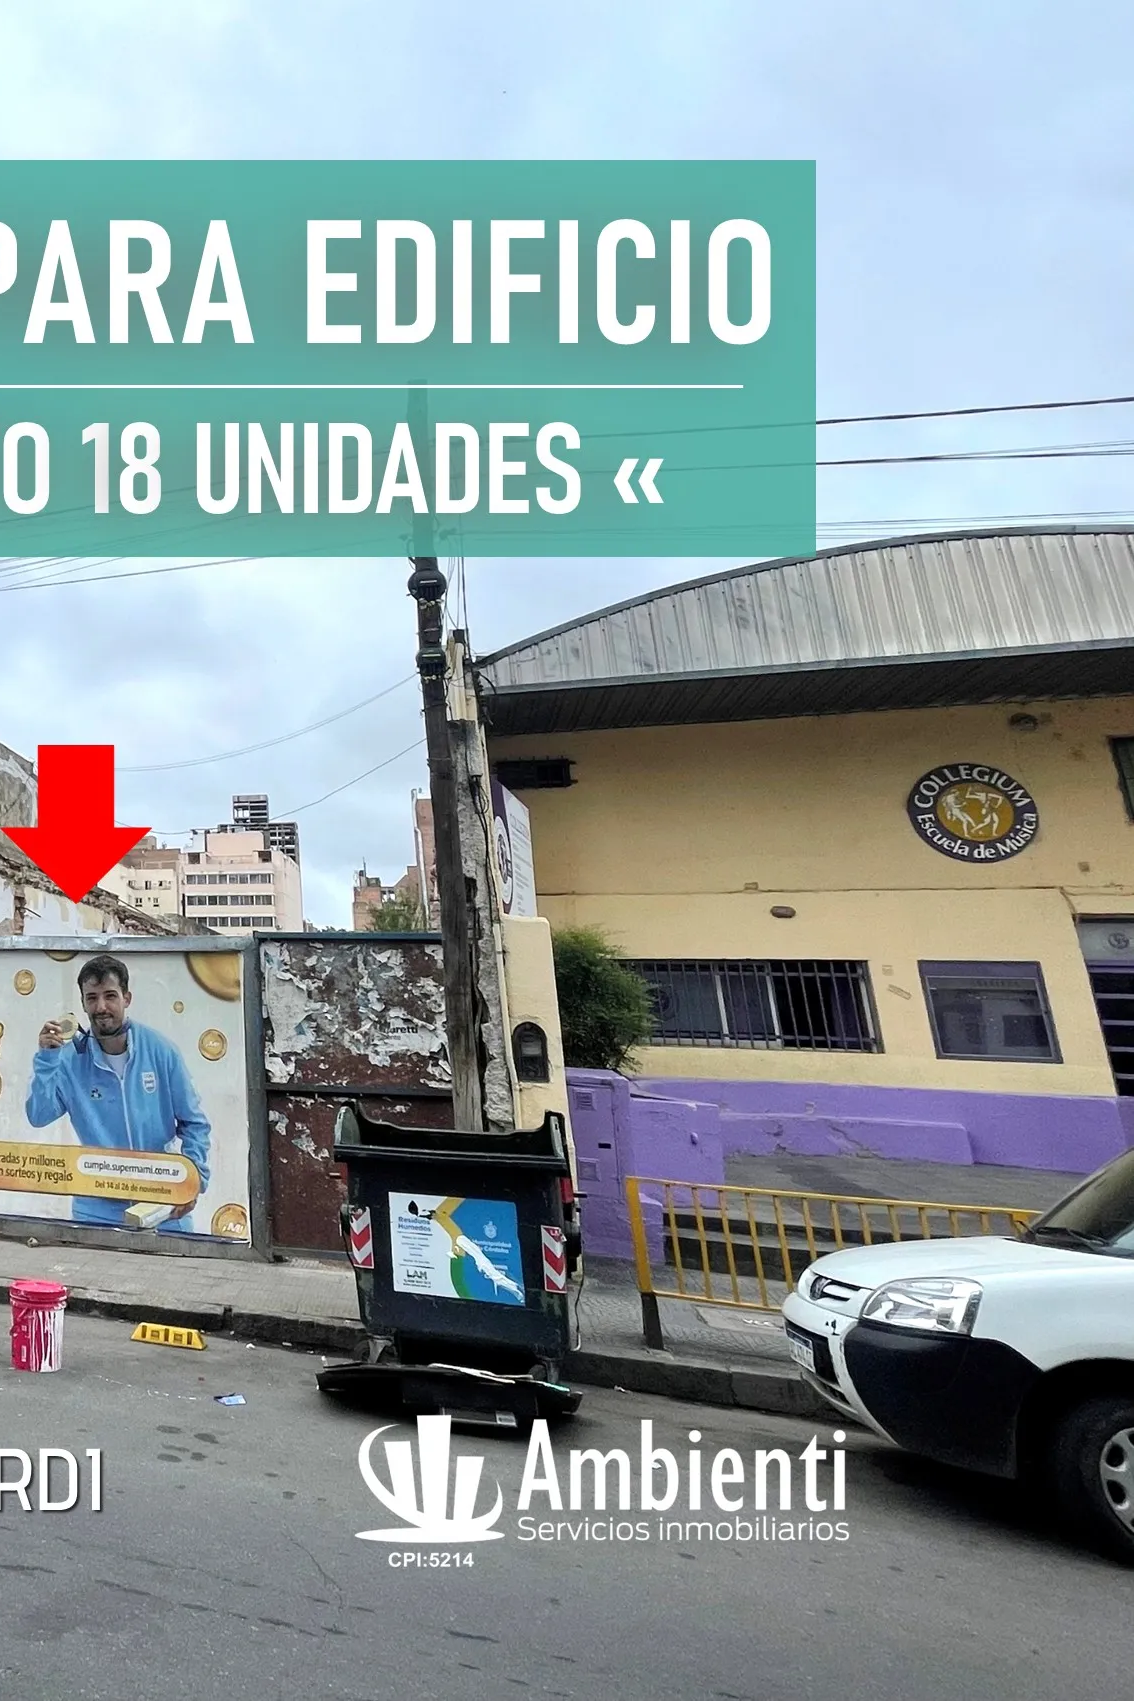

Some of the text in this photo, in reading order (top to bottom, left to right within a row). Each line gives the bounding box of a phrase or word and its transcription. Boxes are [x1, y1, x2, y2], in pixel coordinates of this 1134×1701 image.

[914, 765, 1031, 808] COLLEGIUM
[917, 812, 1037, 859] Escuela de Música
[22, 1156, 28, 1167] y
[29, 1154, 66, 1168] millones
[83, 1160, 180, 1177] cumple.supermami.com.ar
[5, 1168, 36, 1179] sorteos
[37, 1171, 43, 1182] y
[95, 1180, 172, 1195] Del 14 al 26 de noviembre
